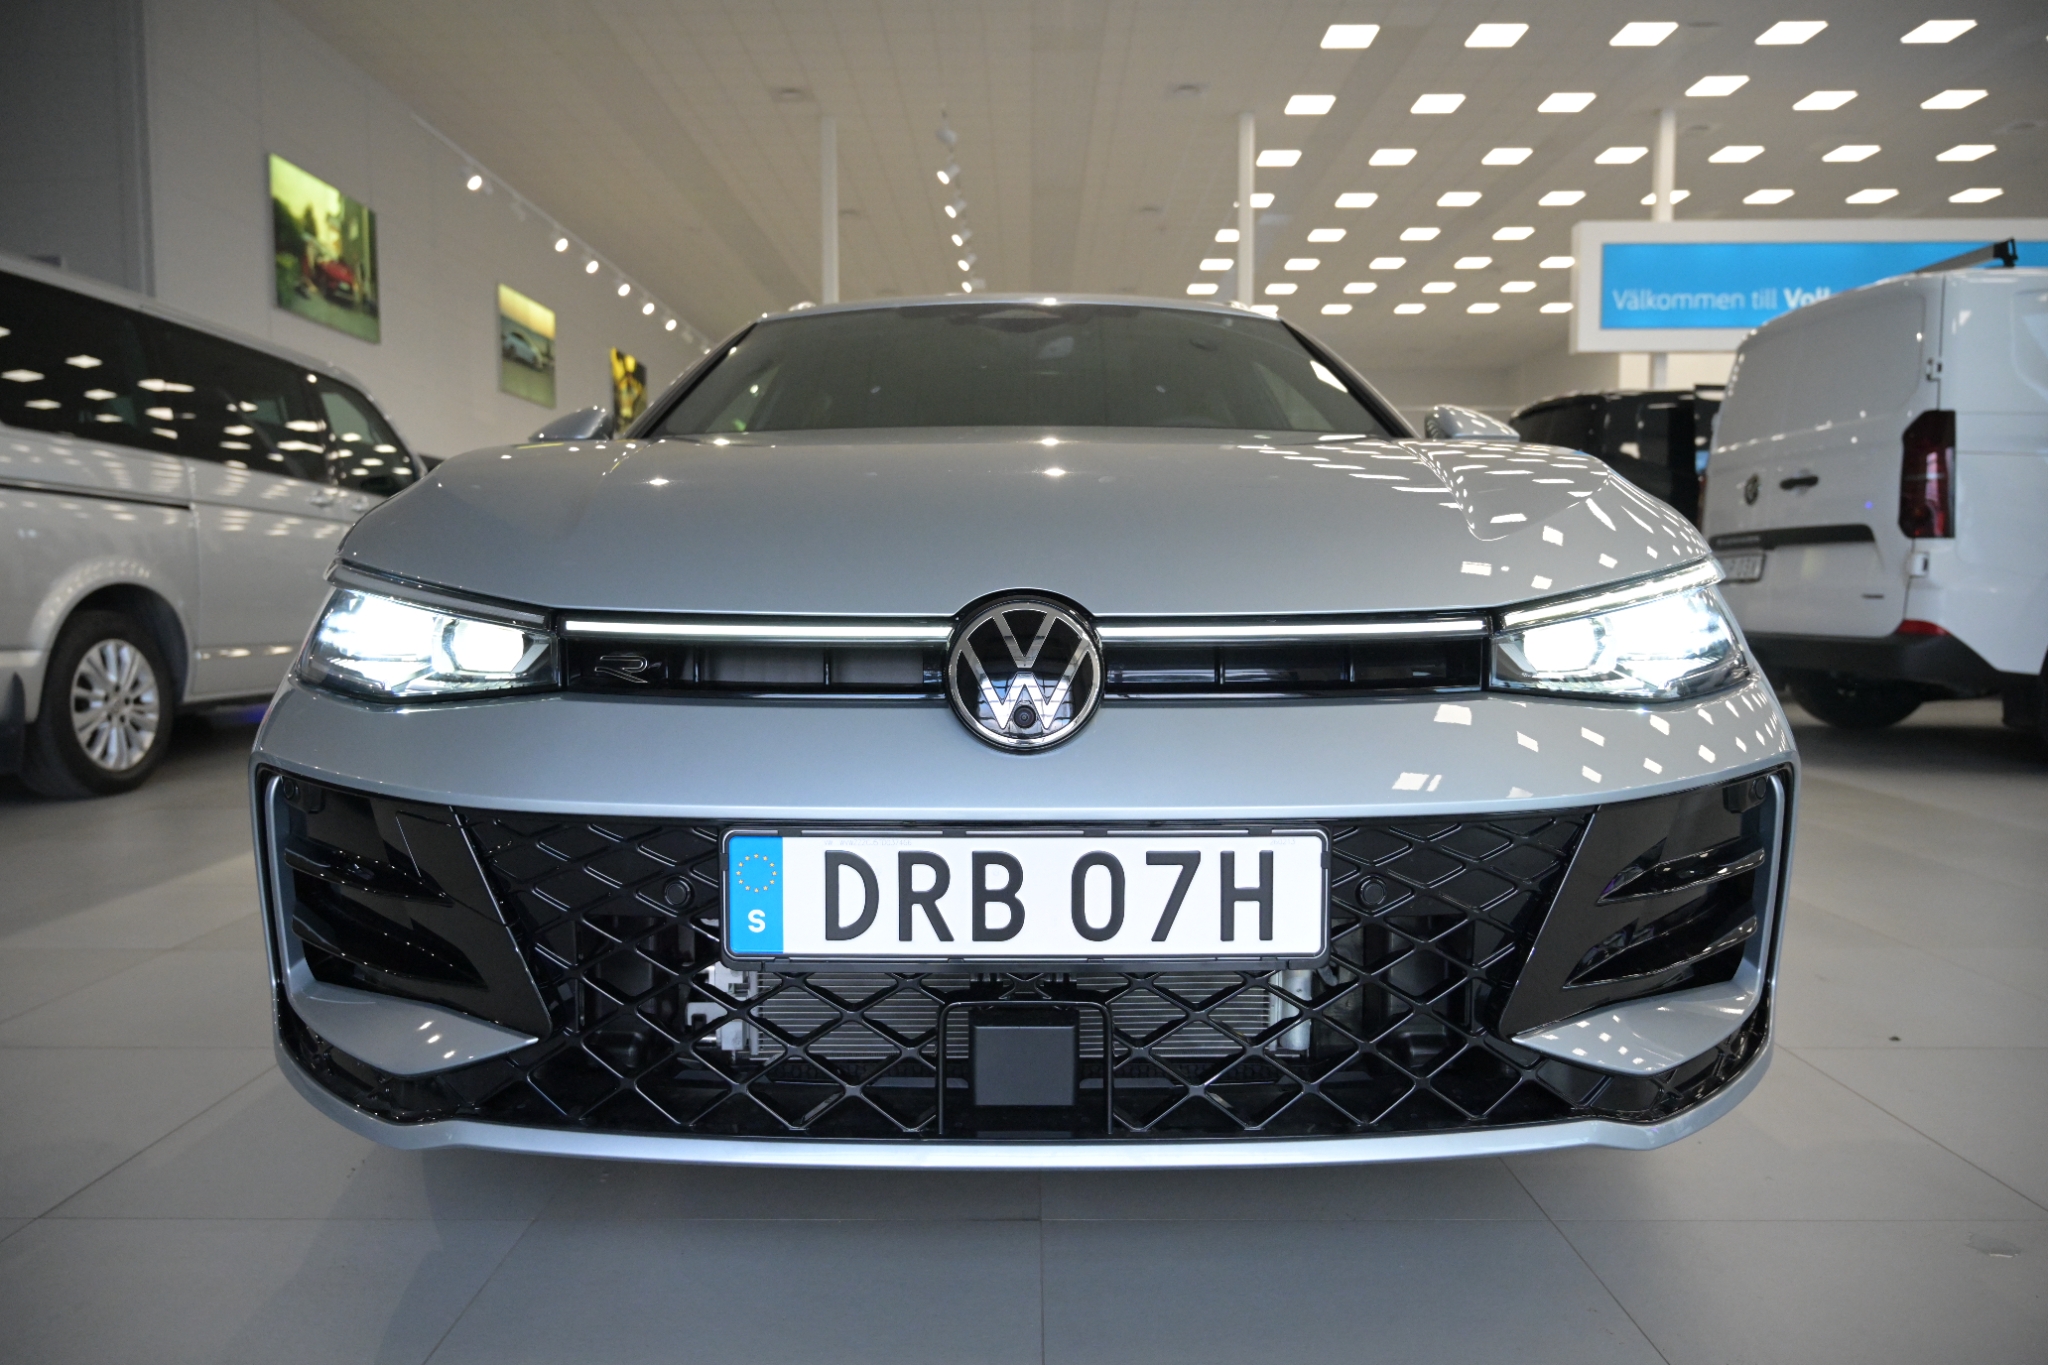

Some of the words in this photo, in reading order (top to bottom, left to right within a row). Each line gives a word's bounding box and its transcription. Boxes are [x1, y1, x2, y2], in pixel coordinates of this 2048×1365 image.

[1613, 289, 1745, 310] Välkommen
[1752, 289, 1777, 309] till
[824, 850, 1026, 942] DRB
[1070, 850, 1274, 942] 07H
[747, 909, 766, 933] S
